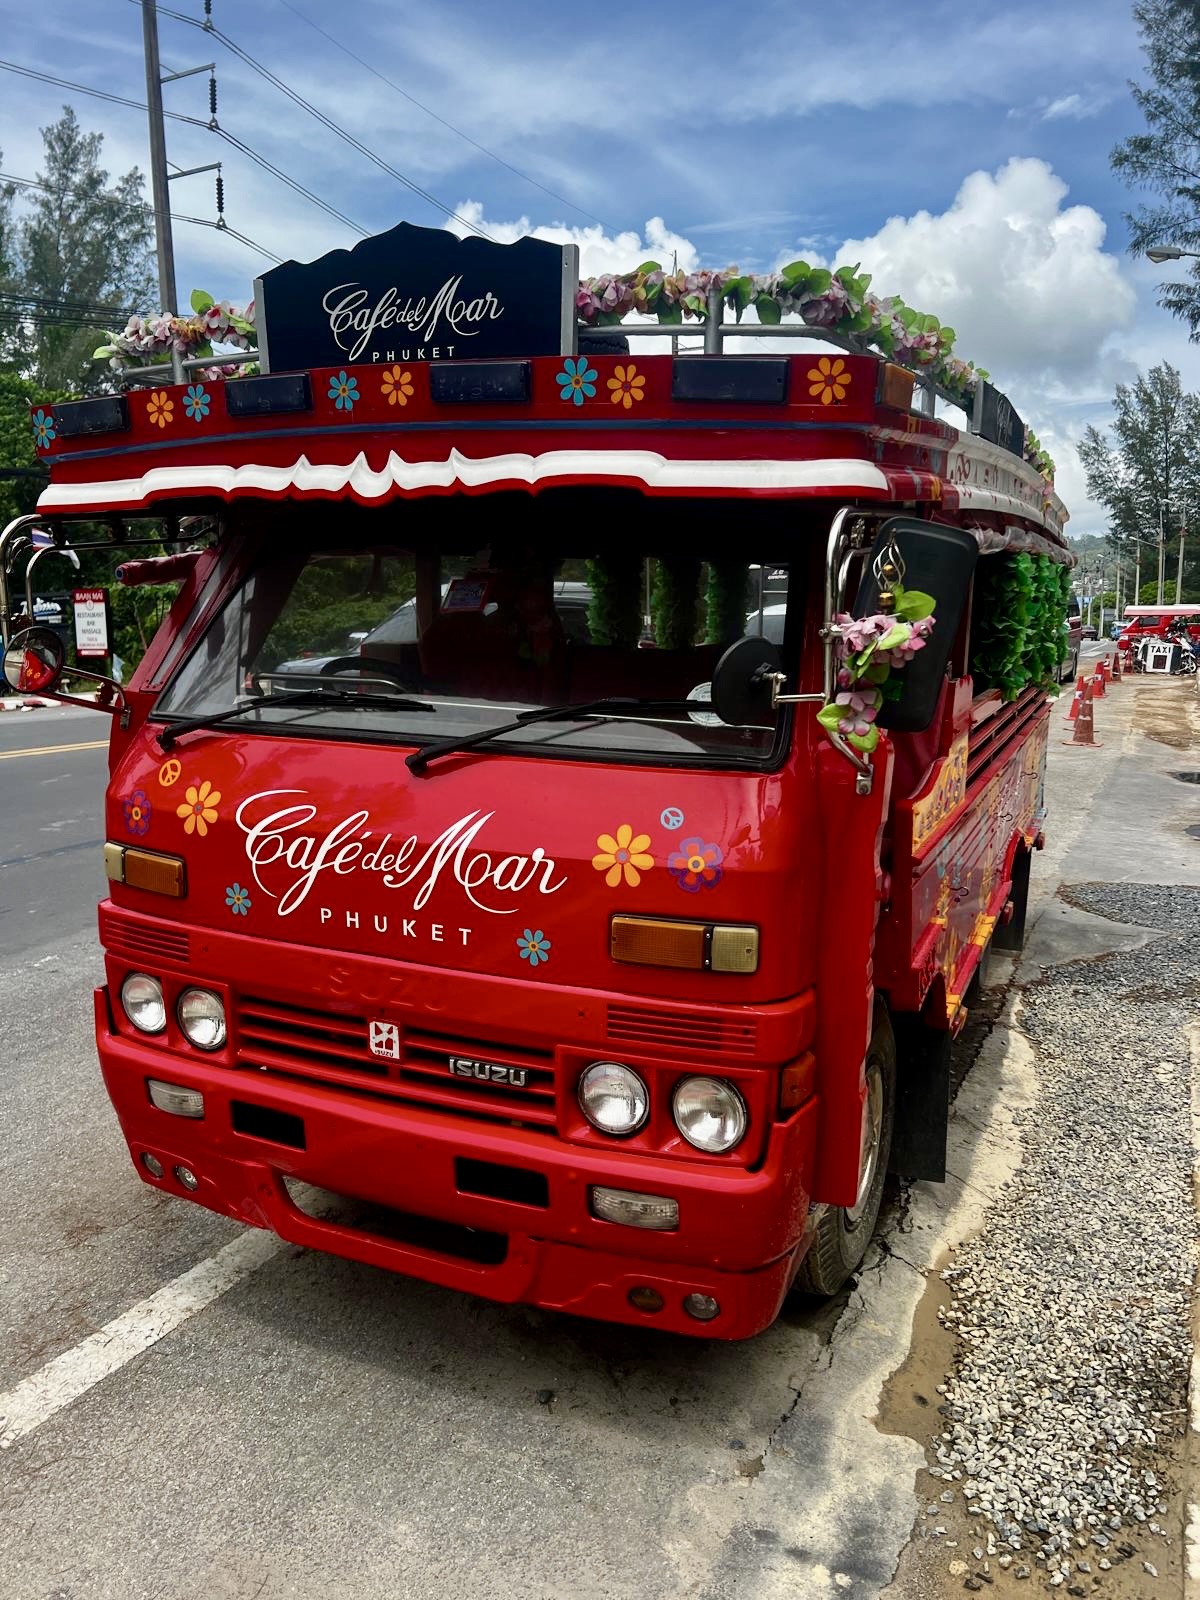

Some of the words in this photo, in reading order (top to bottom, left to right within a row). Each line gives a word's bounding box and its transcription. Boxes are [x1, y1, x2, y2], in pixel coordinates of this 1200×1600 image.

[322, 282, 399, 361] Café
[396, 297, 424, 323] del
[408, 274, 504, 342] Mar
[372, 346, 456, 362] PHUKET
[1151, 645, 1171, 654] TAXI
[235, 789, 371, 916] Café
[362, 833, 418, 874] del
[384, 808, 567, 915] Mar
[320, 908, 472, 946] PHUKET
[374, 1050, 394, 1058] ISUZU
[449, 1057, 526, 1087] ISUZU
